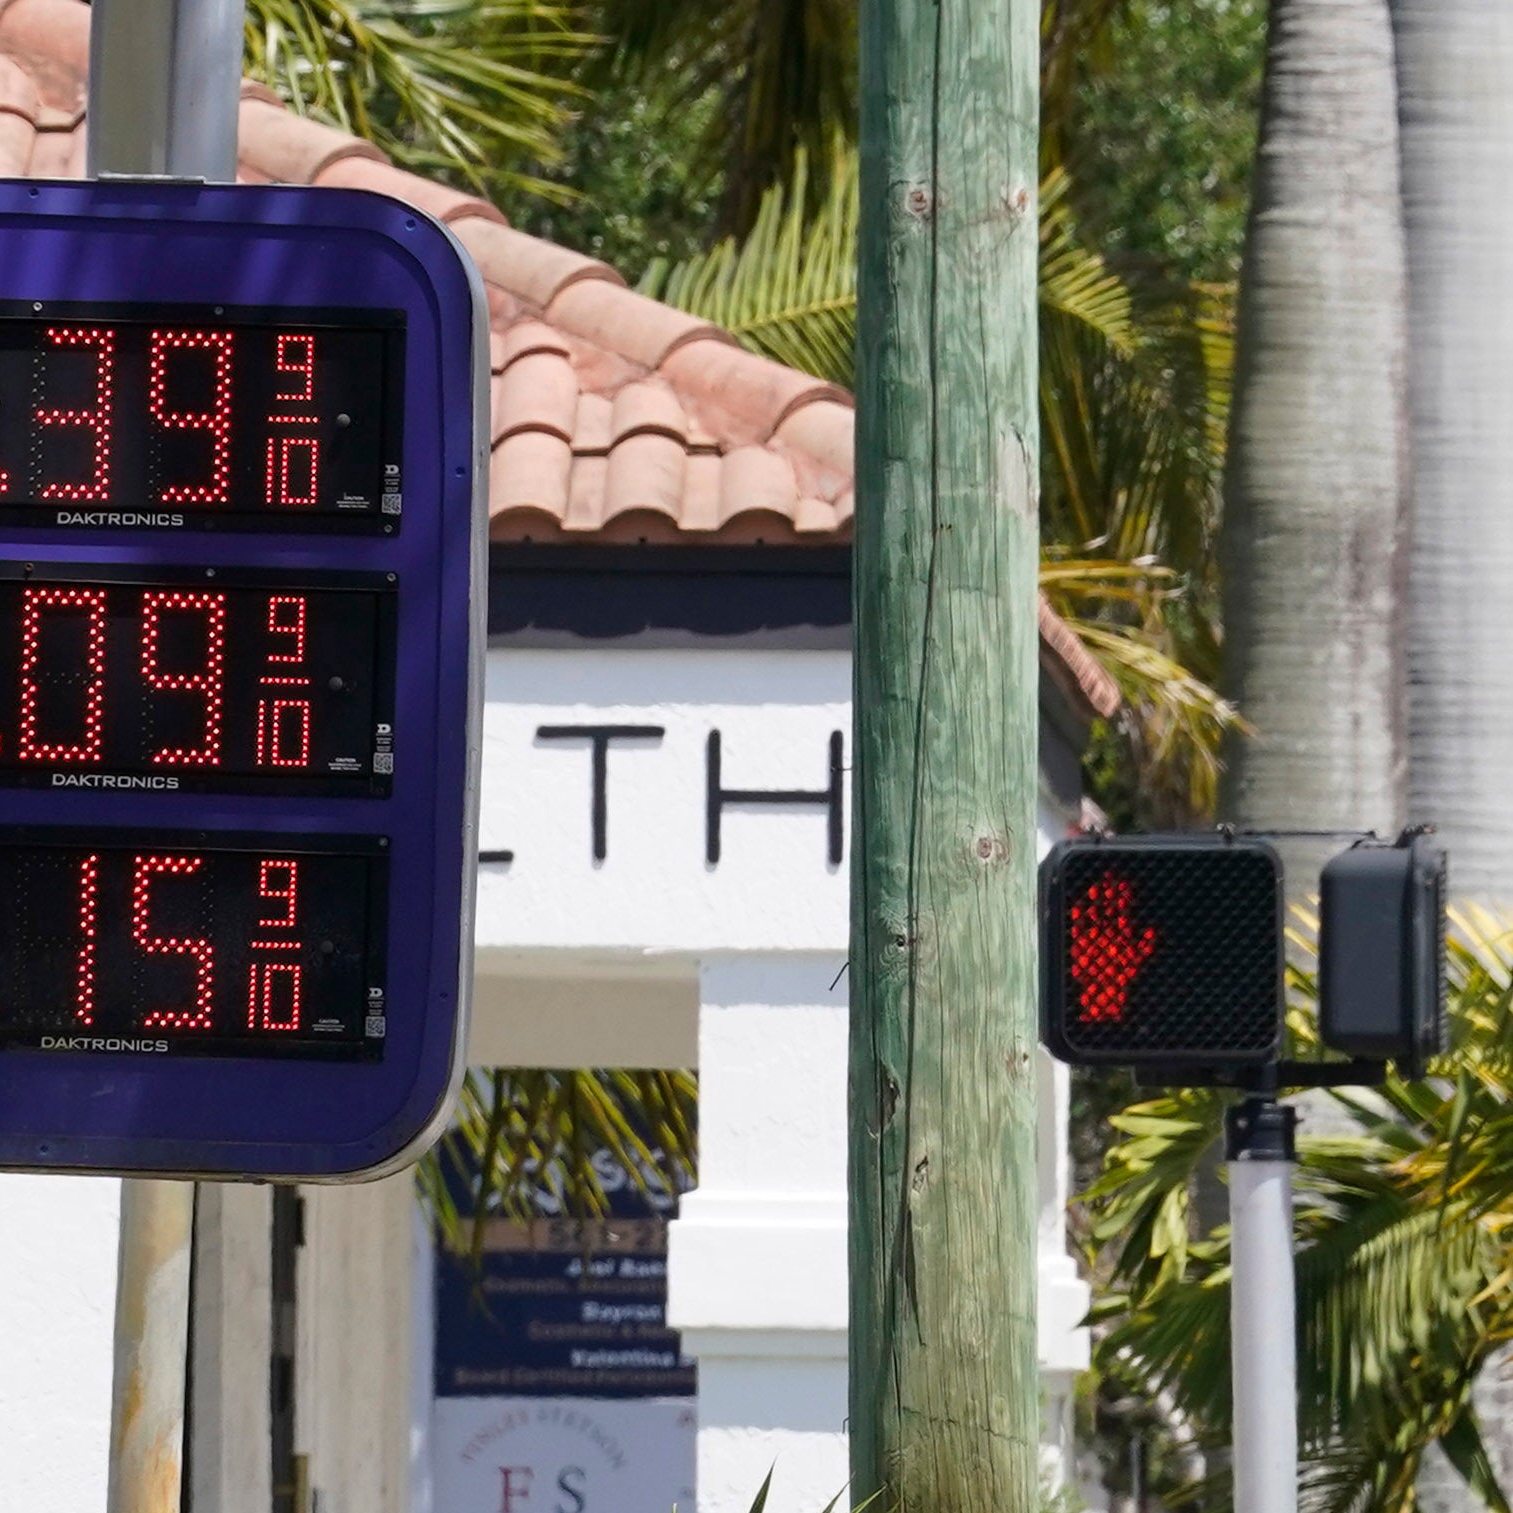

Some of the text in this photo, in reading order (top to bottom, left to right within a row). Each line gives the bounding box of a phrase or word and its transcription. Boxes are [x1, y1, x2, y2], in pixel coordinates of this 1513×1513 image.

[56, 511, 184, 527] DAKTRONICS
[51, 772, 180, 789] DAKTRONICS
[479, 725, 844, 865] TH
[40, 1035, 169, 1053] DAKTRONICS
